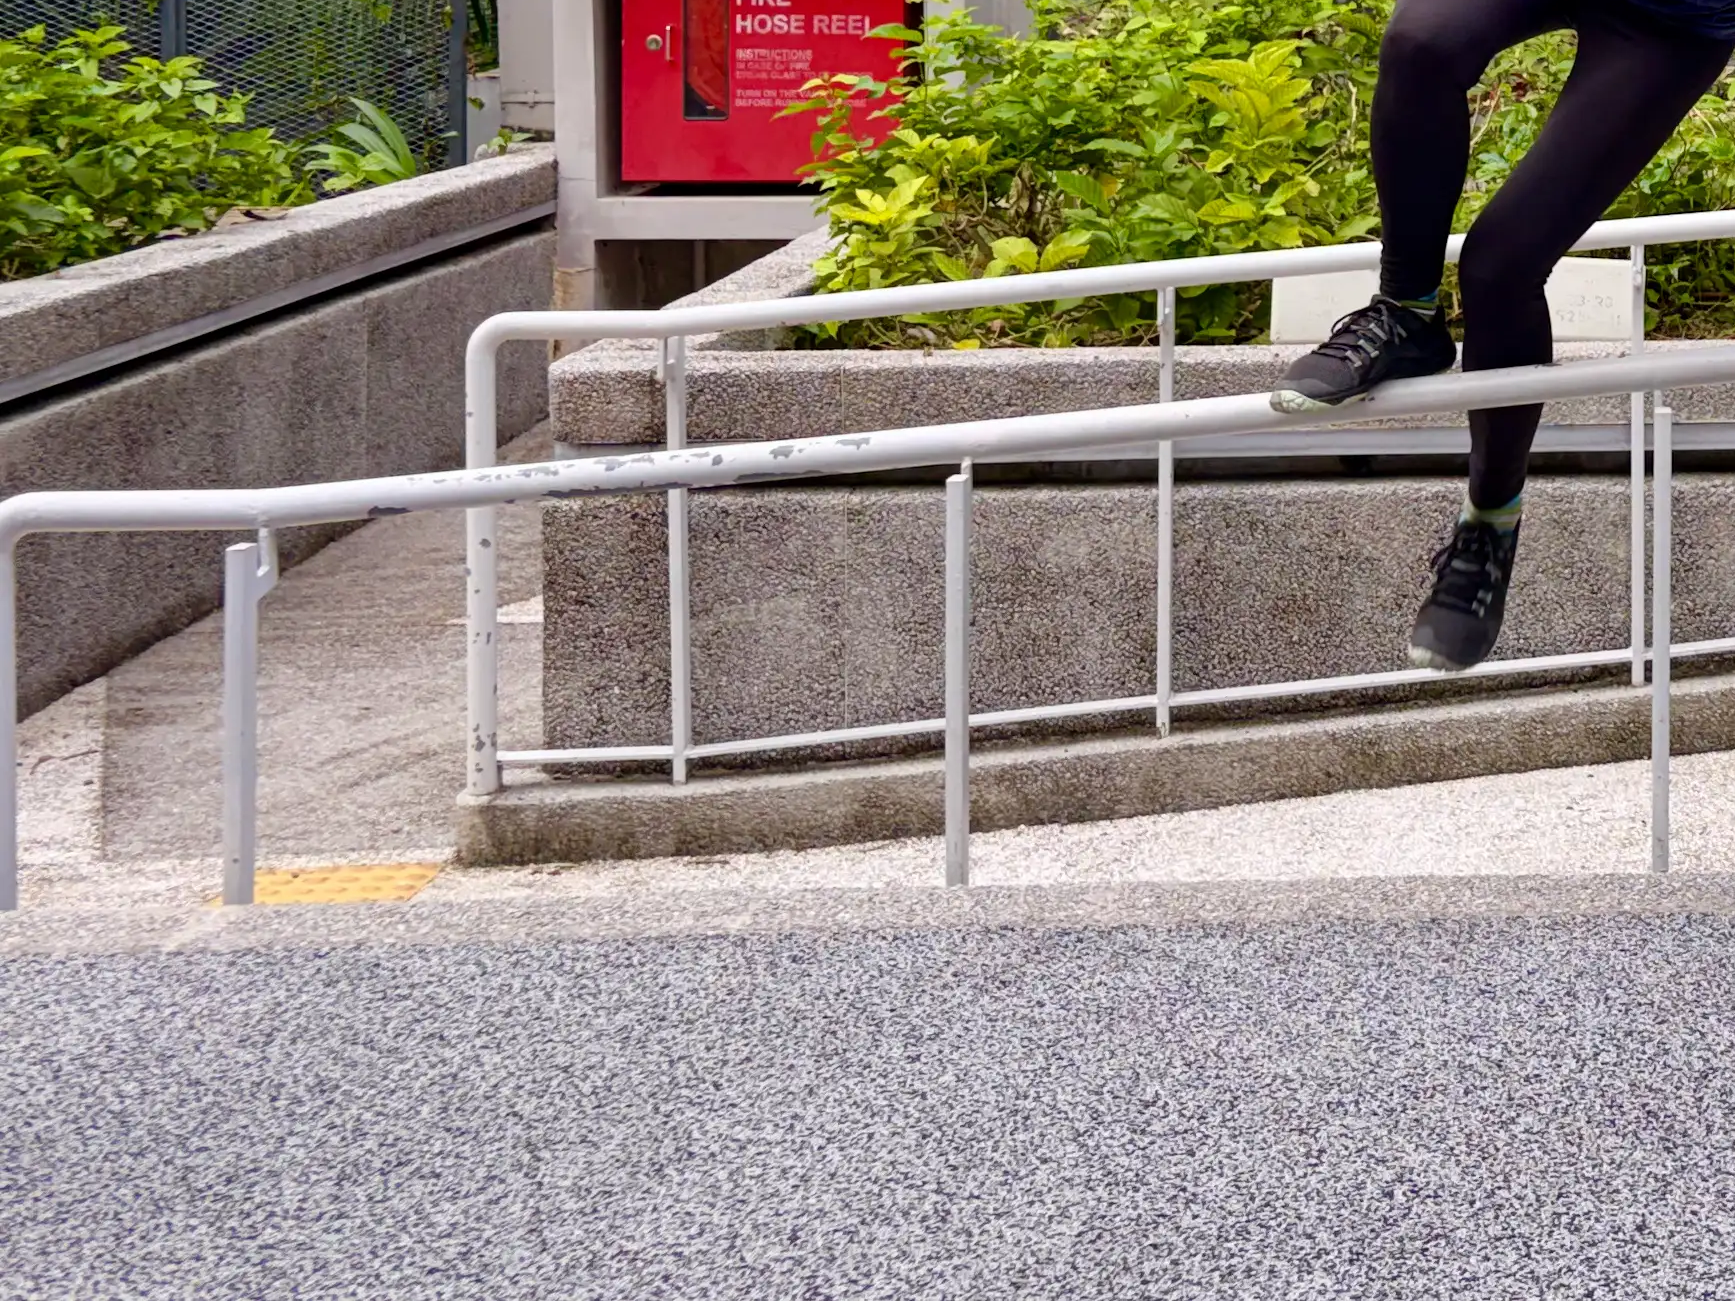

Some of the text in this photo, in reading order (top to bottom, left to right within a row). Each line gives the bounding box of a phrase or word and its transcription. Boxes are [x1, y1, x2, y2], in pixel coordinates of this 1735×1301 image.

[735, 14, 806, 34] HOSE
[735, 48, 813, 61] INSTRUCTIONS
[735, 98, 774, 107] BEFORE
